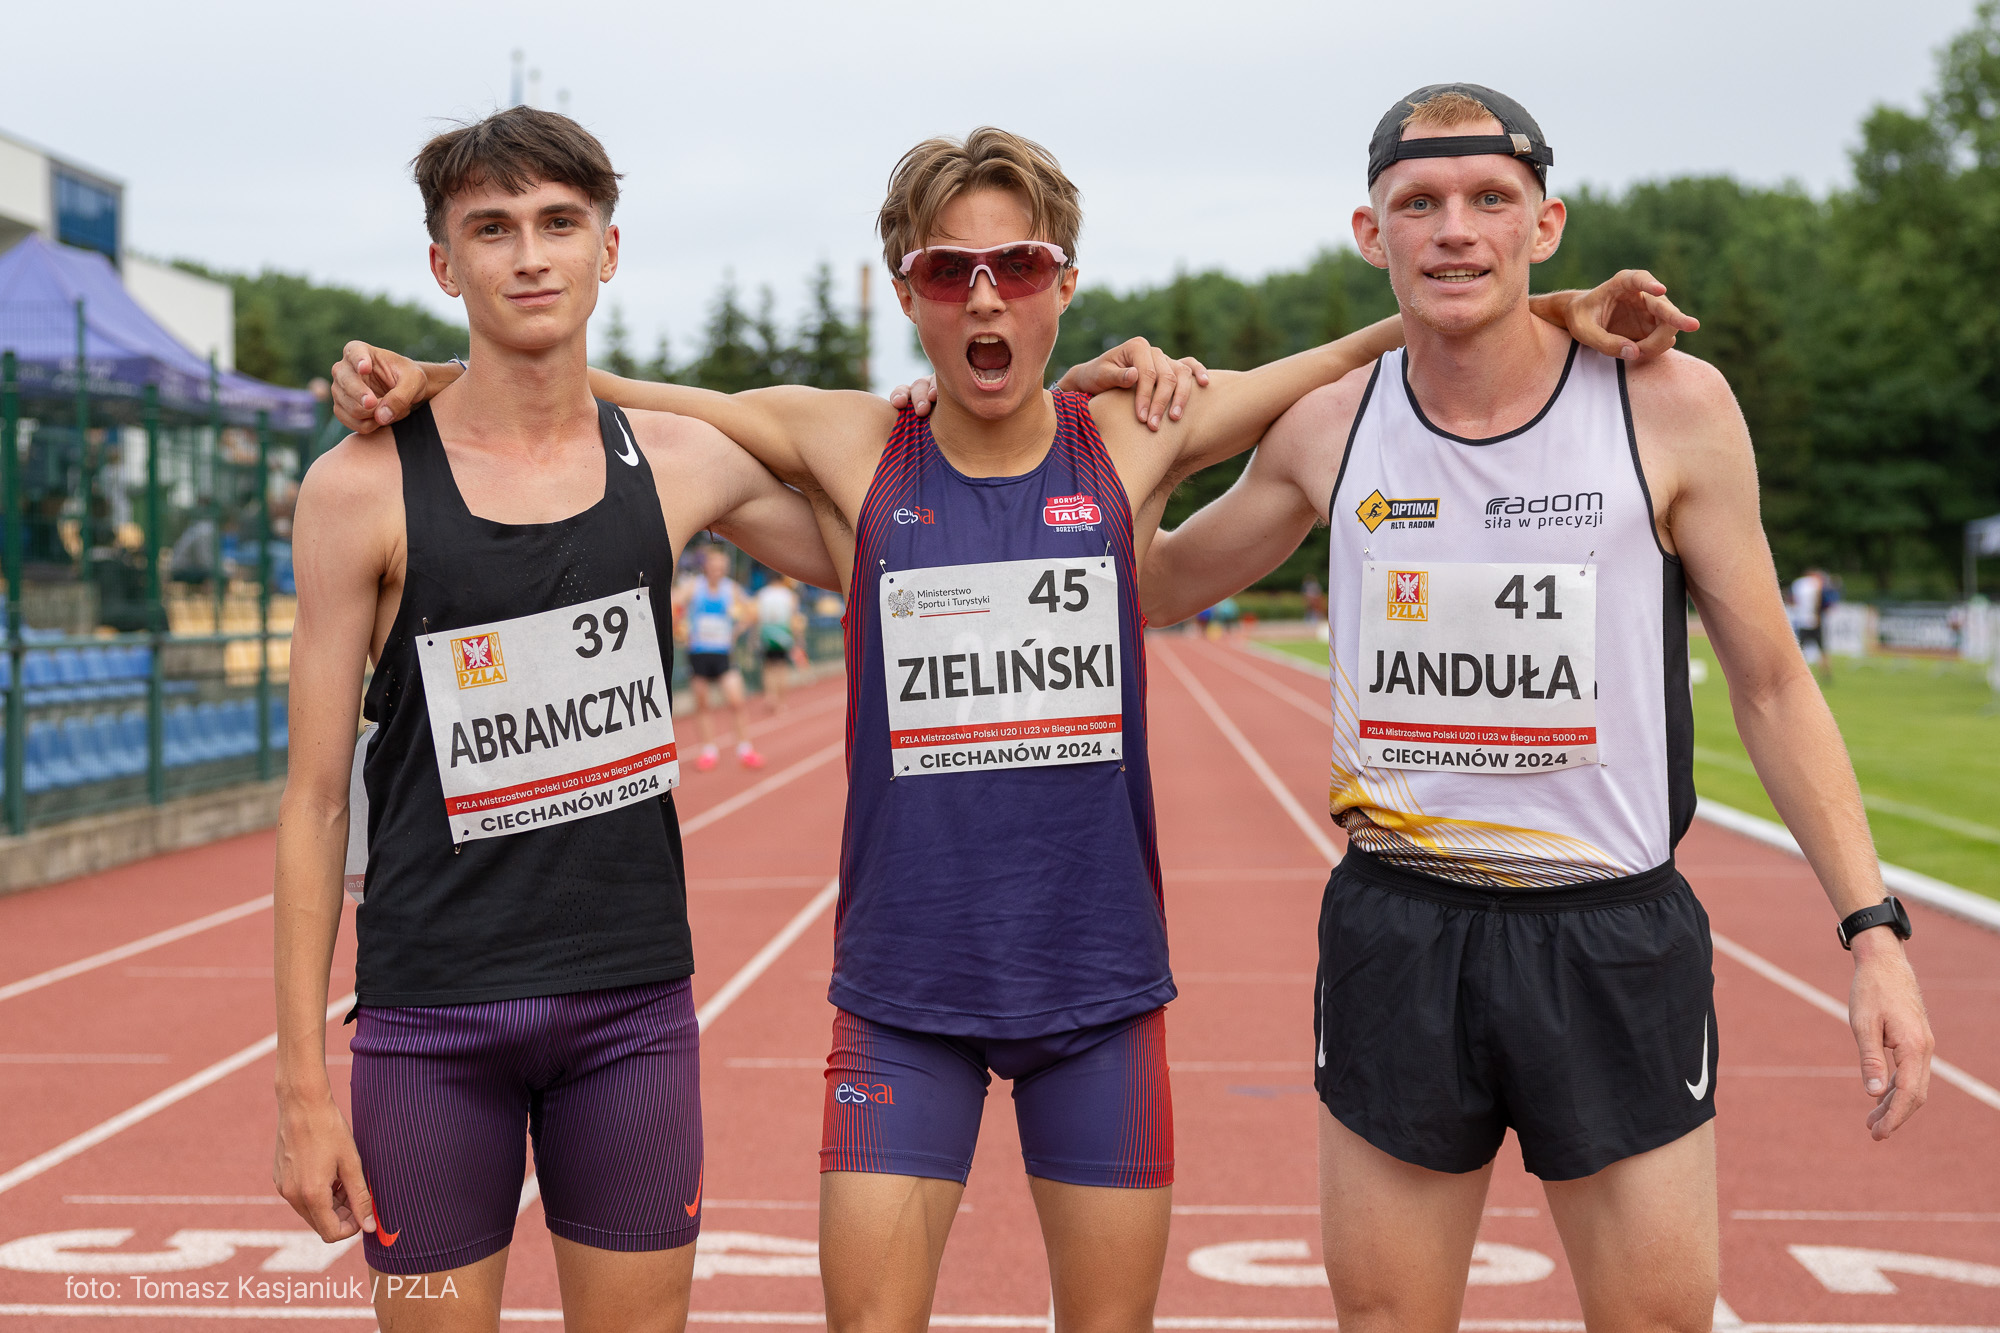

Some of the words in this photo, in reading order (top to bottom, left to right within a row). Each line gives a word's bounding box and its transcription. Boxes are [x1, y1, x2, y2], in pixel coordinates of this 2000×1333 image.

[1392, 502, 1435, 516] OPTIMA
[1390, 522, 1406, 530] RLTL
[1408, 521, 1435, 529] RADOM
[1484, 516, 1510, 528] siła
[1518, 518, 1530, 528] w
[1538, 512, 1602, 529] precyzji
[918, 588, 972, 598] Ministerstwo
[1028, 568, 1089, 613] 45
[1494, 574, 1562, 620] 41
[918, 599, 946, 610] Sportu
[952, 596, 990, 607] Turystyki
[1388, 604, 1425, 620] PZLA
[572, 606, 628, 658] 39
[460, 667, 504, 686] PZLA
[898, 638, 1114, 702] ZIELIŃSKI
[1368, 650, 1582, 700] JANDUŁA
[450, 676, 662, 768] ABRAMCZYK
[900, 735, 920, 744] PZLA
[921, 732, 972, 742] Mistrzostwa
[974, 729, 998, 738] Polski
[1000, 728, 1018, 736] U20
[1019, 726, 1022, 735] i
[1024, 726, 1041, 735] U23
[1052, 724, 1076, 735] Biegu
[1090, 722, 1108, 730] 5000
[1367, 727, 1384, 736] PZLA
[1385, 728, 1432, 738] Mistrzostwa
[1433, 730, 1458, 740] Polski
[1459, 732, 1476, 740] U20
[1477, 732, 1480, 740] i
[1482, 732, 1499, 741] U23
[1510, 732, 1536, 744] Biegu
[1552, 733, 1576, 742] 5000
[920, 742, 1051, 768] CIECHANÓW
[1056, 742, 1102, 758] 2024
[1382, 748, 1509, 768] CIECHANÓW
[1514, 752, 1568, 768] 2024
[456, 800, 478, 810] PZLA
[479, 788, 533, 806] Mistrzostwa
[535, 783, 561, 796] Polski
[562, 779, 579, 789] U20
[580, 776, 584, 785] i
[586, 772, 602, 784] U23
[603, 771, 610, 779] w
[611, 764, 633, 777] Biegu
[633, 761, 643, 769] na
[644, 755, 662, 766] 5000
[663, 751, 671, 760] m
[480, 790, 614, 832] CIECHANÓW
[618, 775, 659, 801] 2024
